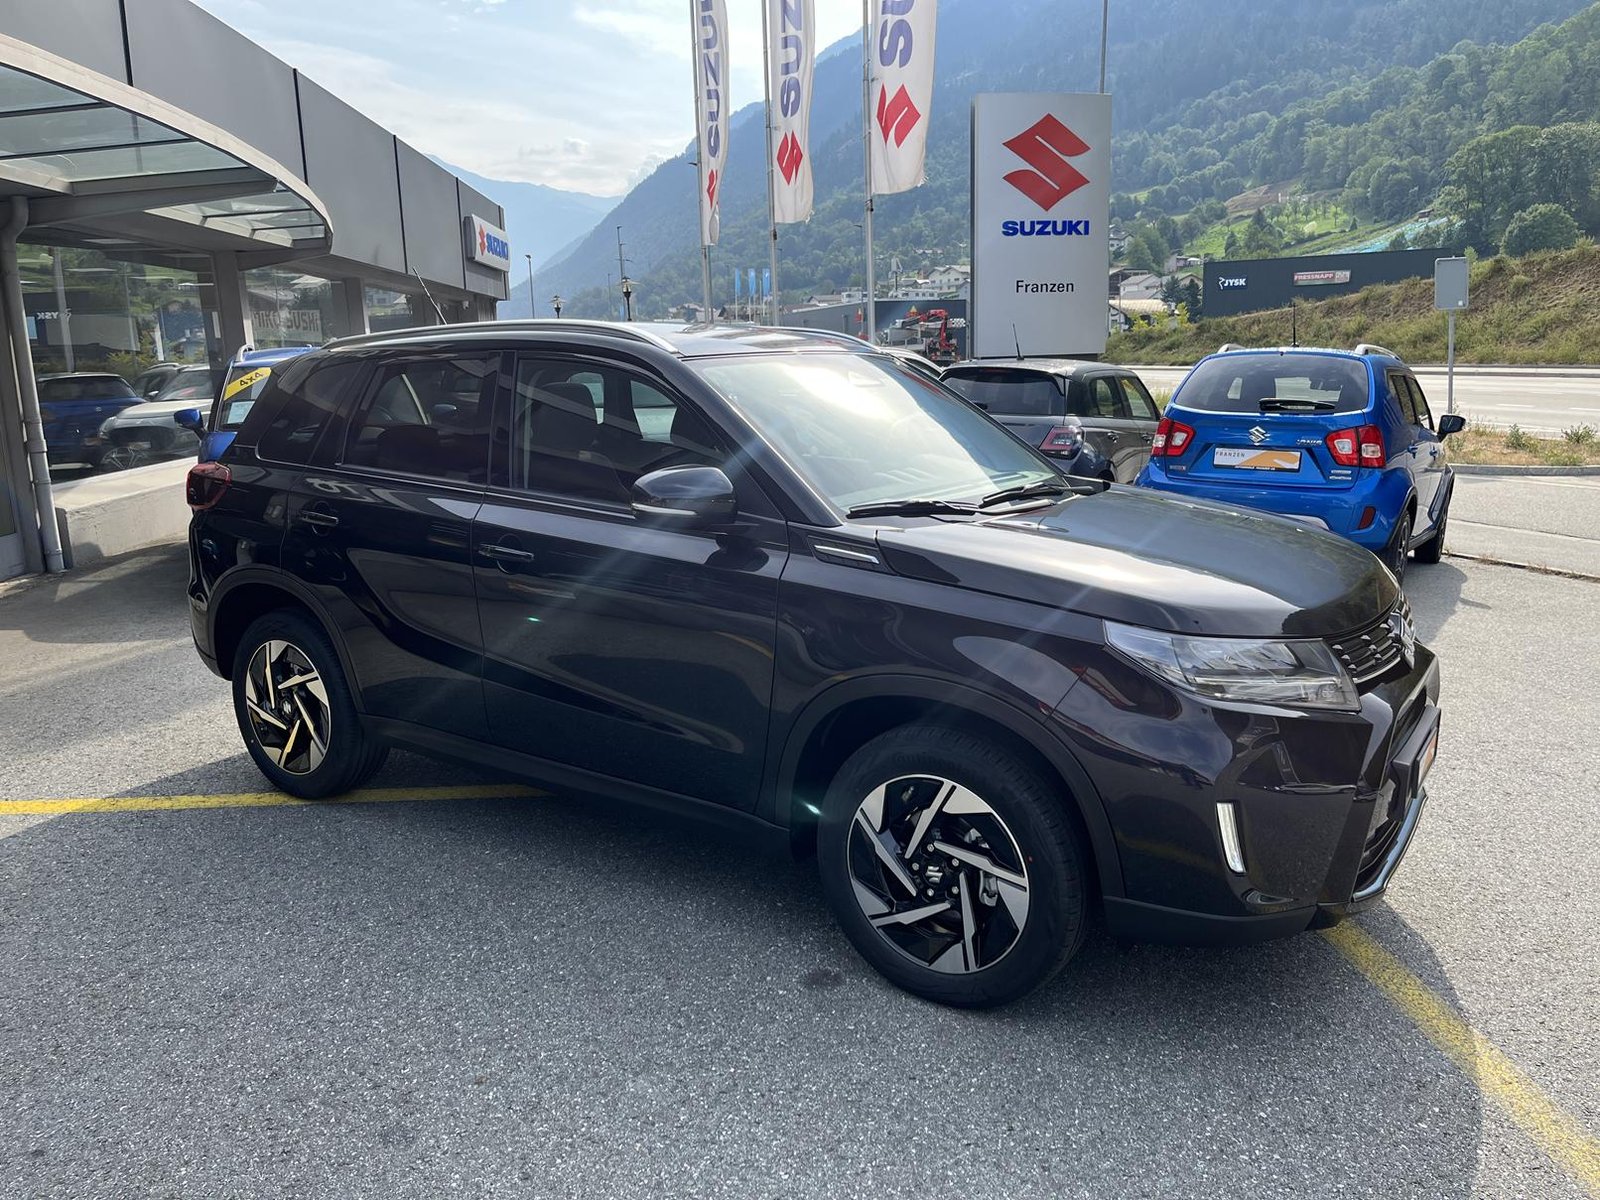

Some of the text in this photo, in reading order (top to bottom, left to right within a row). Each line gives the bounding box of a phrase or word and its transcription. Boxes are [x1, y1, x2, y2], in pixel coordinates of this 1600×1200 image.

[1001, 219, 1090, 237] SUZUKI
[486, 232, 509, 261] SUZUKI
[1016, 280, 1075, 293] Franzen
[1223, 276, 1247, 287] JYSK
[1216, 451, 1246, 459] FRANZEN
